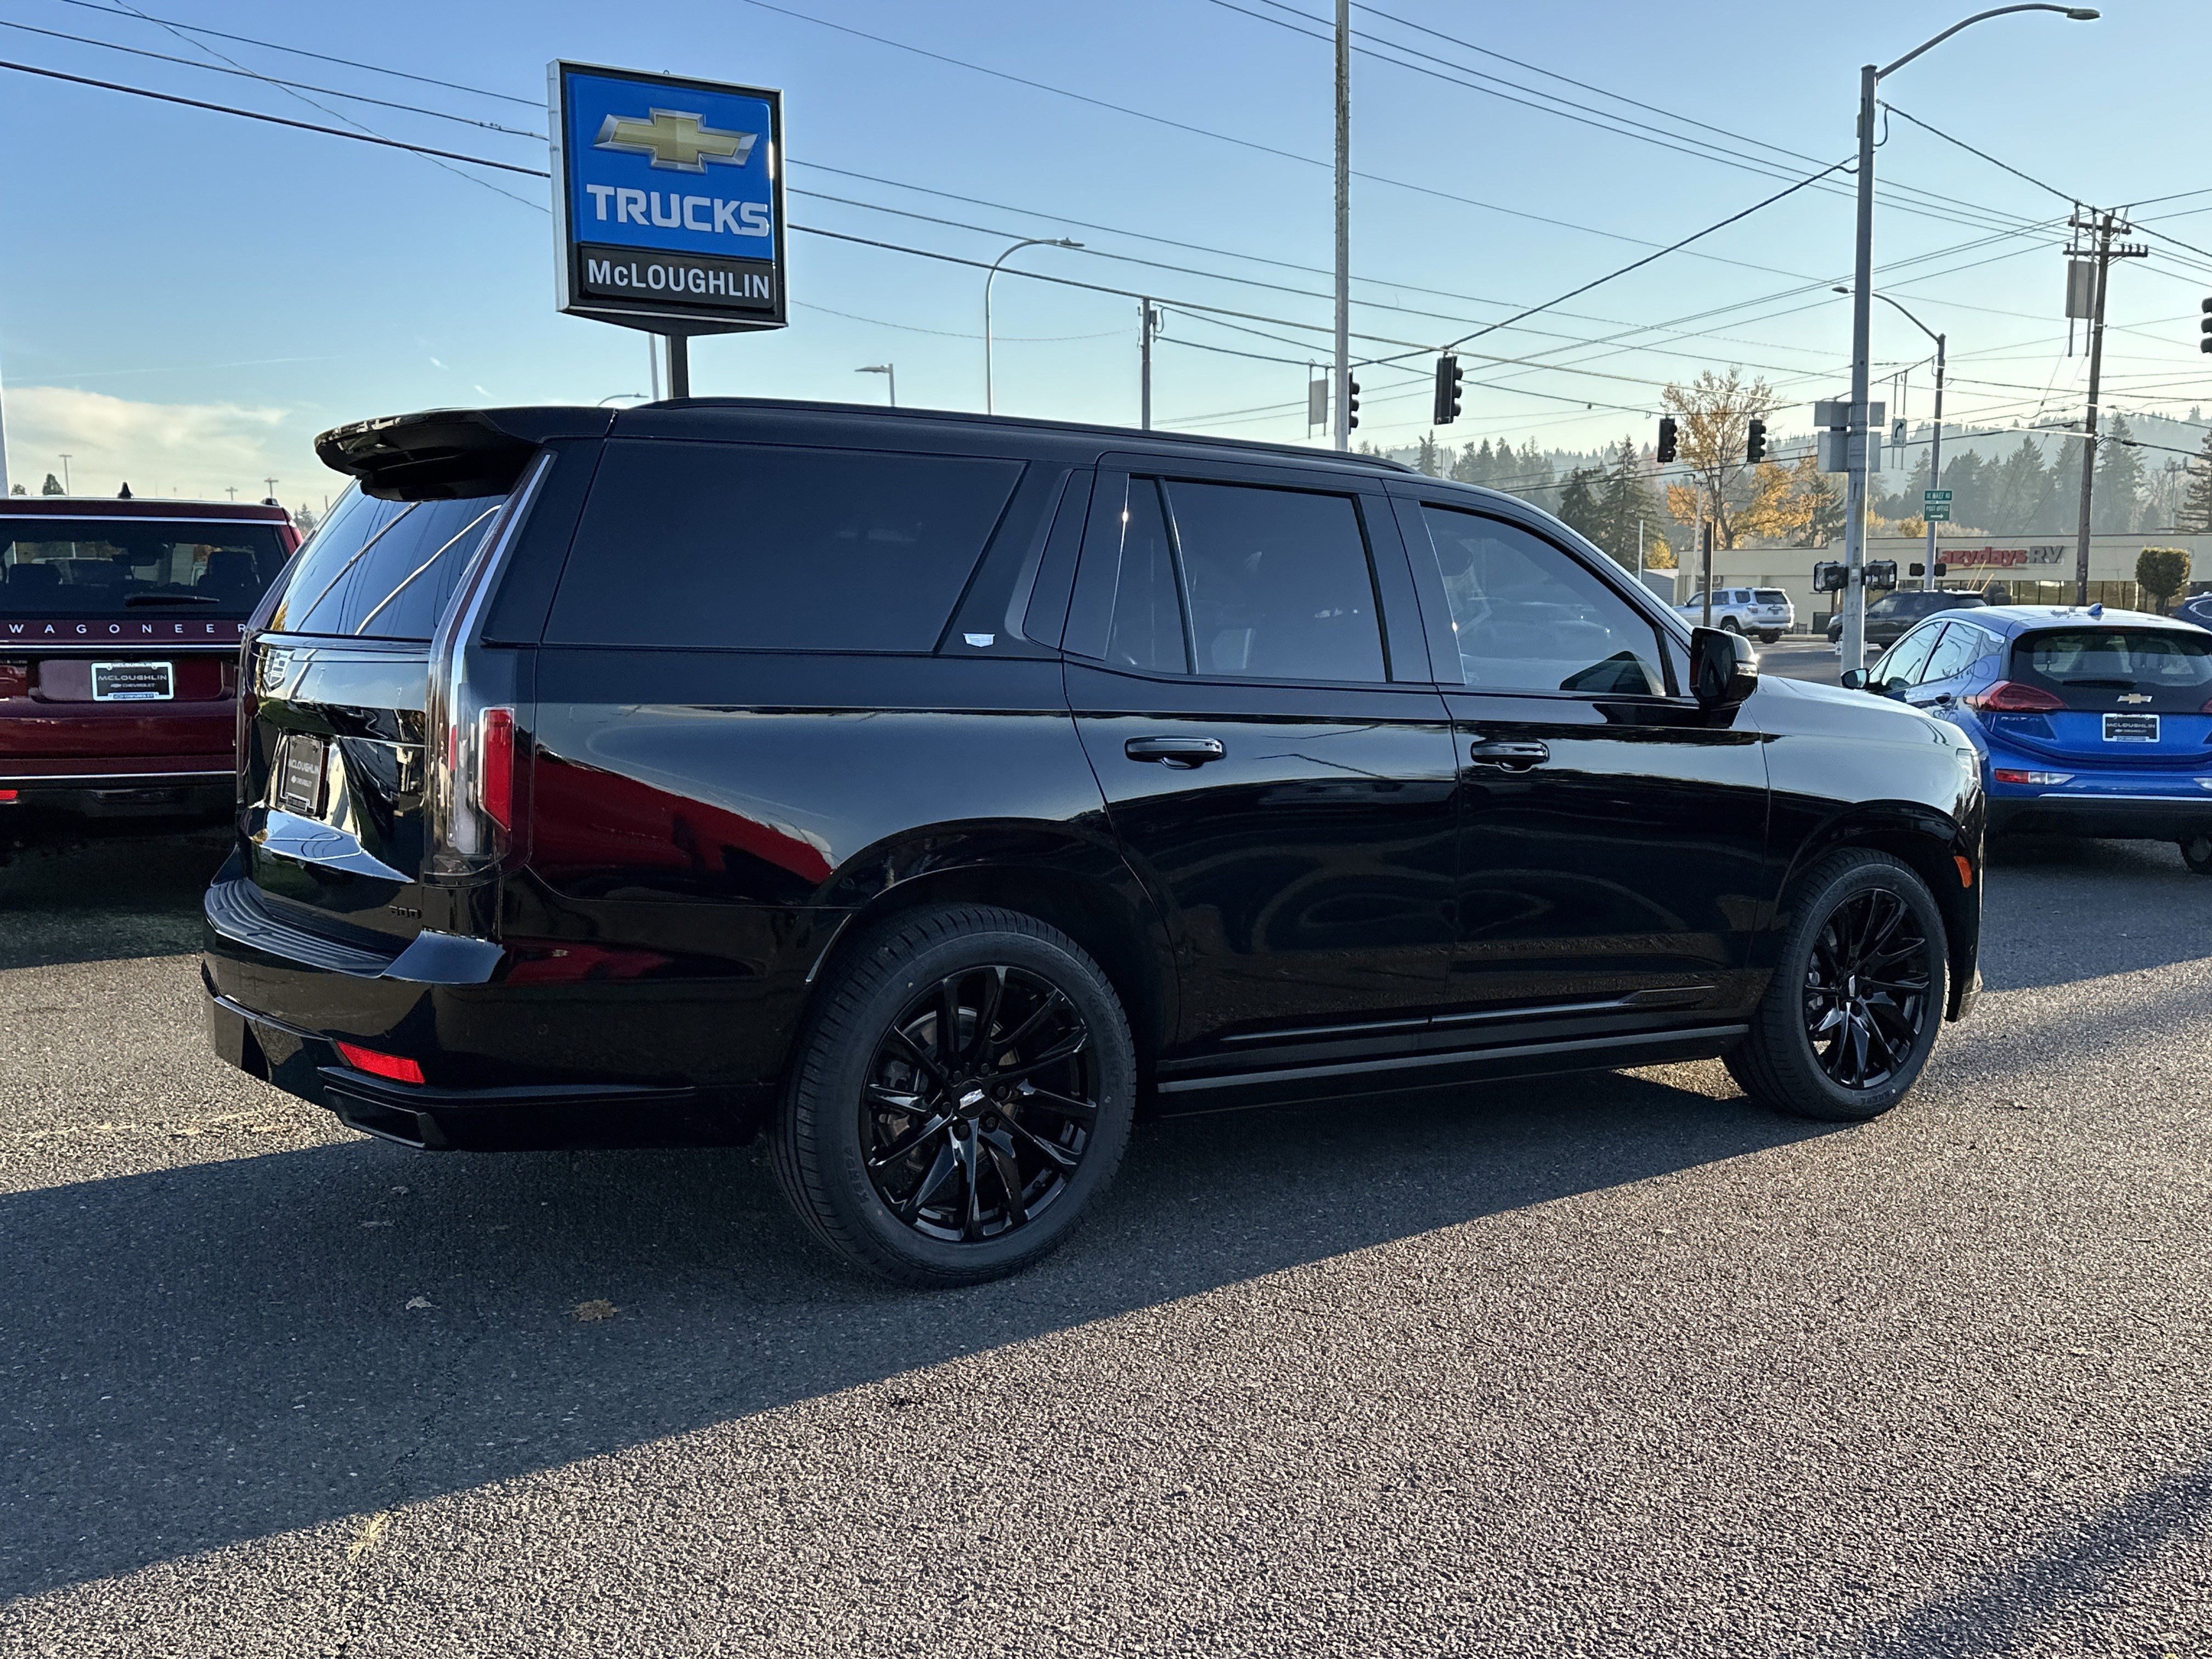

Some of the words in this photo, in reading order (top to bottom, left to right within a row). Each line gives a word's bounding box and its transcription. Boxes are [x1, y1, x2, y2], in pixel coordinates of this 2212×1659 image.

[586, 184, 769, 237] TRUCKS
[588, 259, 769, 300] McLOUGHLIN
[9, 623, 246, 634] WAGONEER
